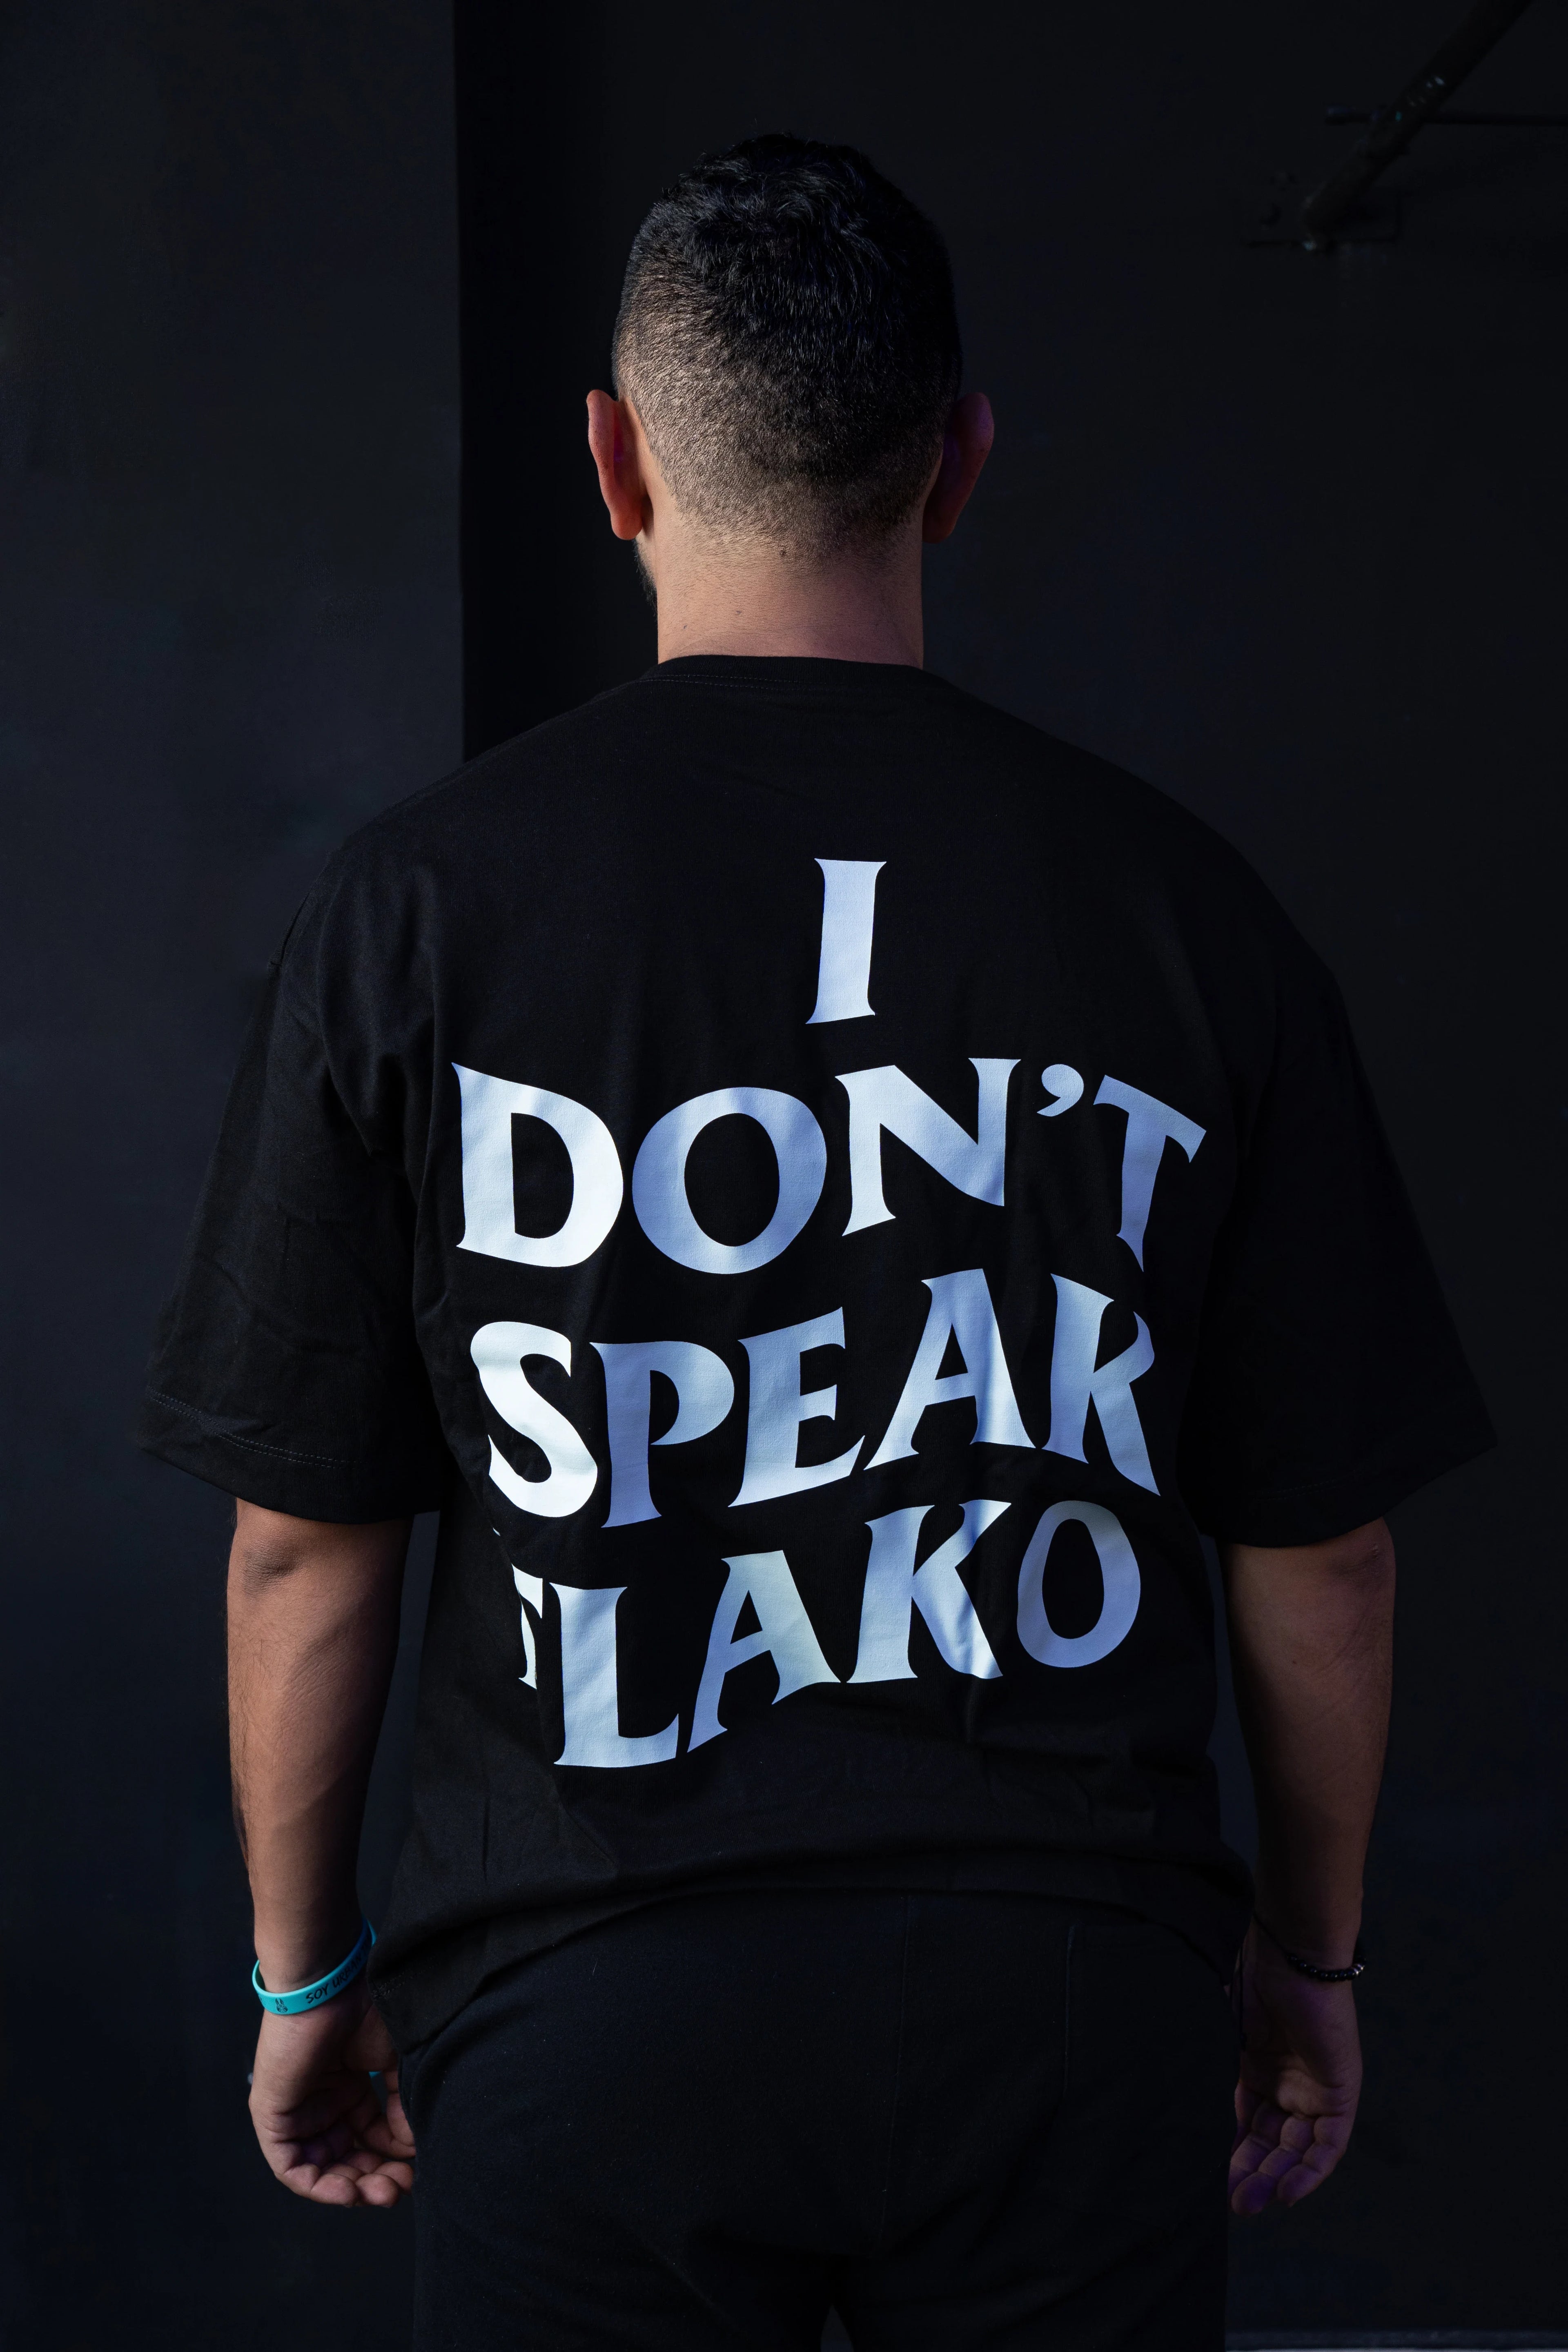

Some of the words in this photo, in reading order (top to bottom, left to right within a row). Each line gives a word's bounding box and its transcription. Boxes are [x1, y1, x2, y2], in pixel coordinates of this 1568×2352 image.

[805, 858, 887, 1025] I
[451, 1057, 1207, 1275] DON'T
[470, 1268, 1158, 1528] SPEAK
[306, 1983, 329, 2004] SOY
